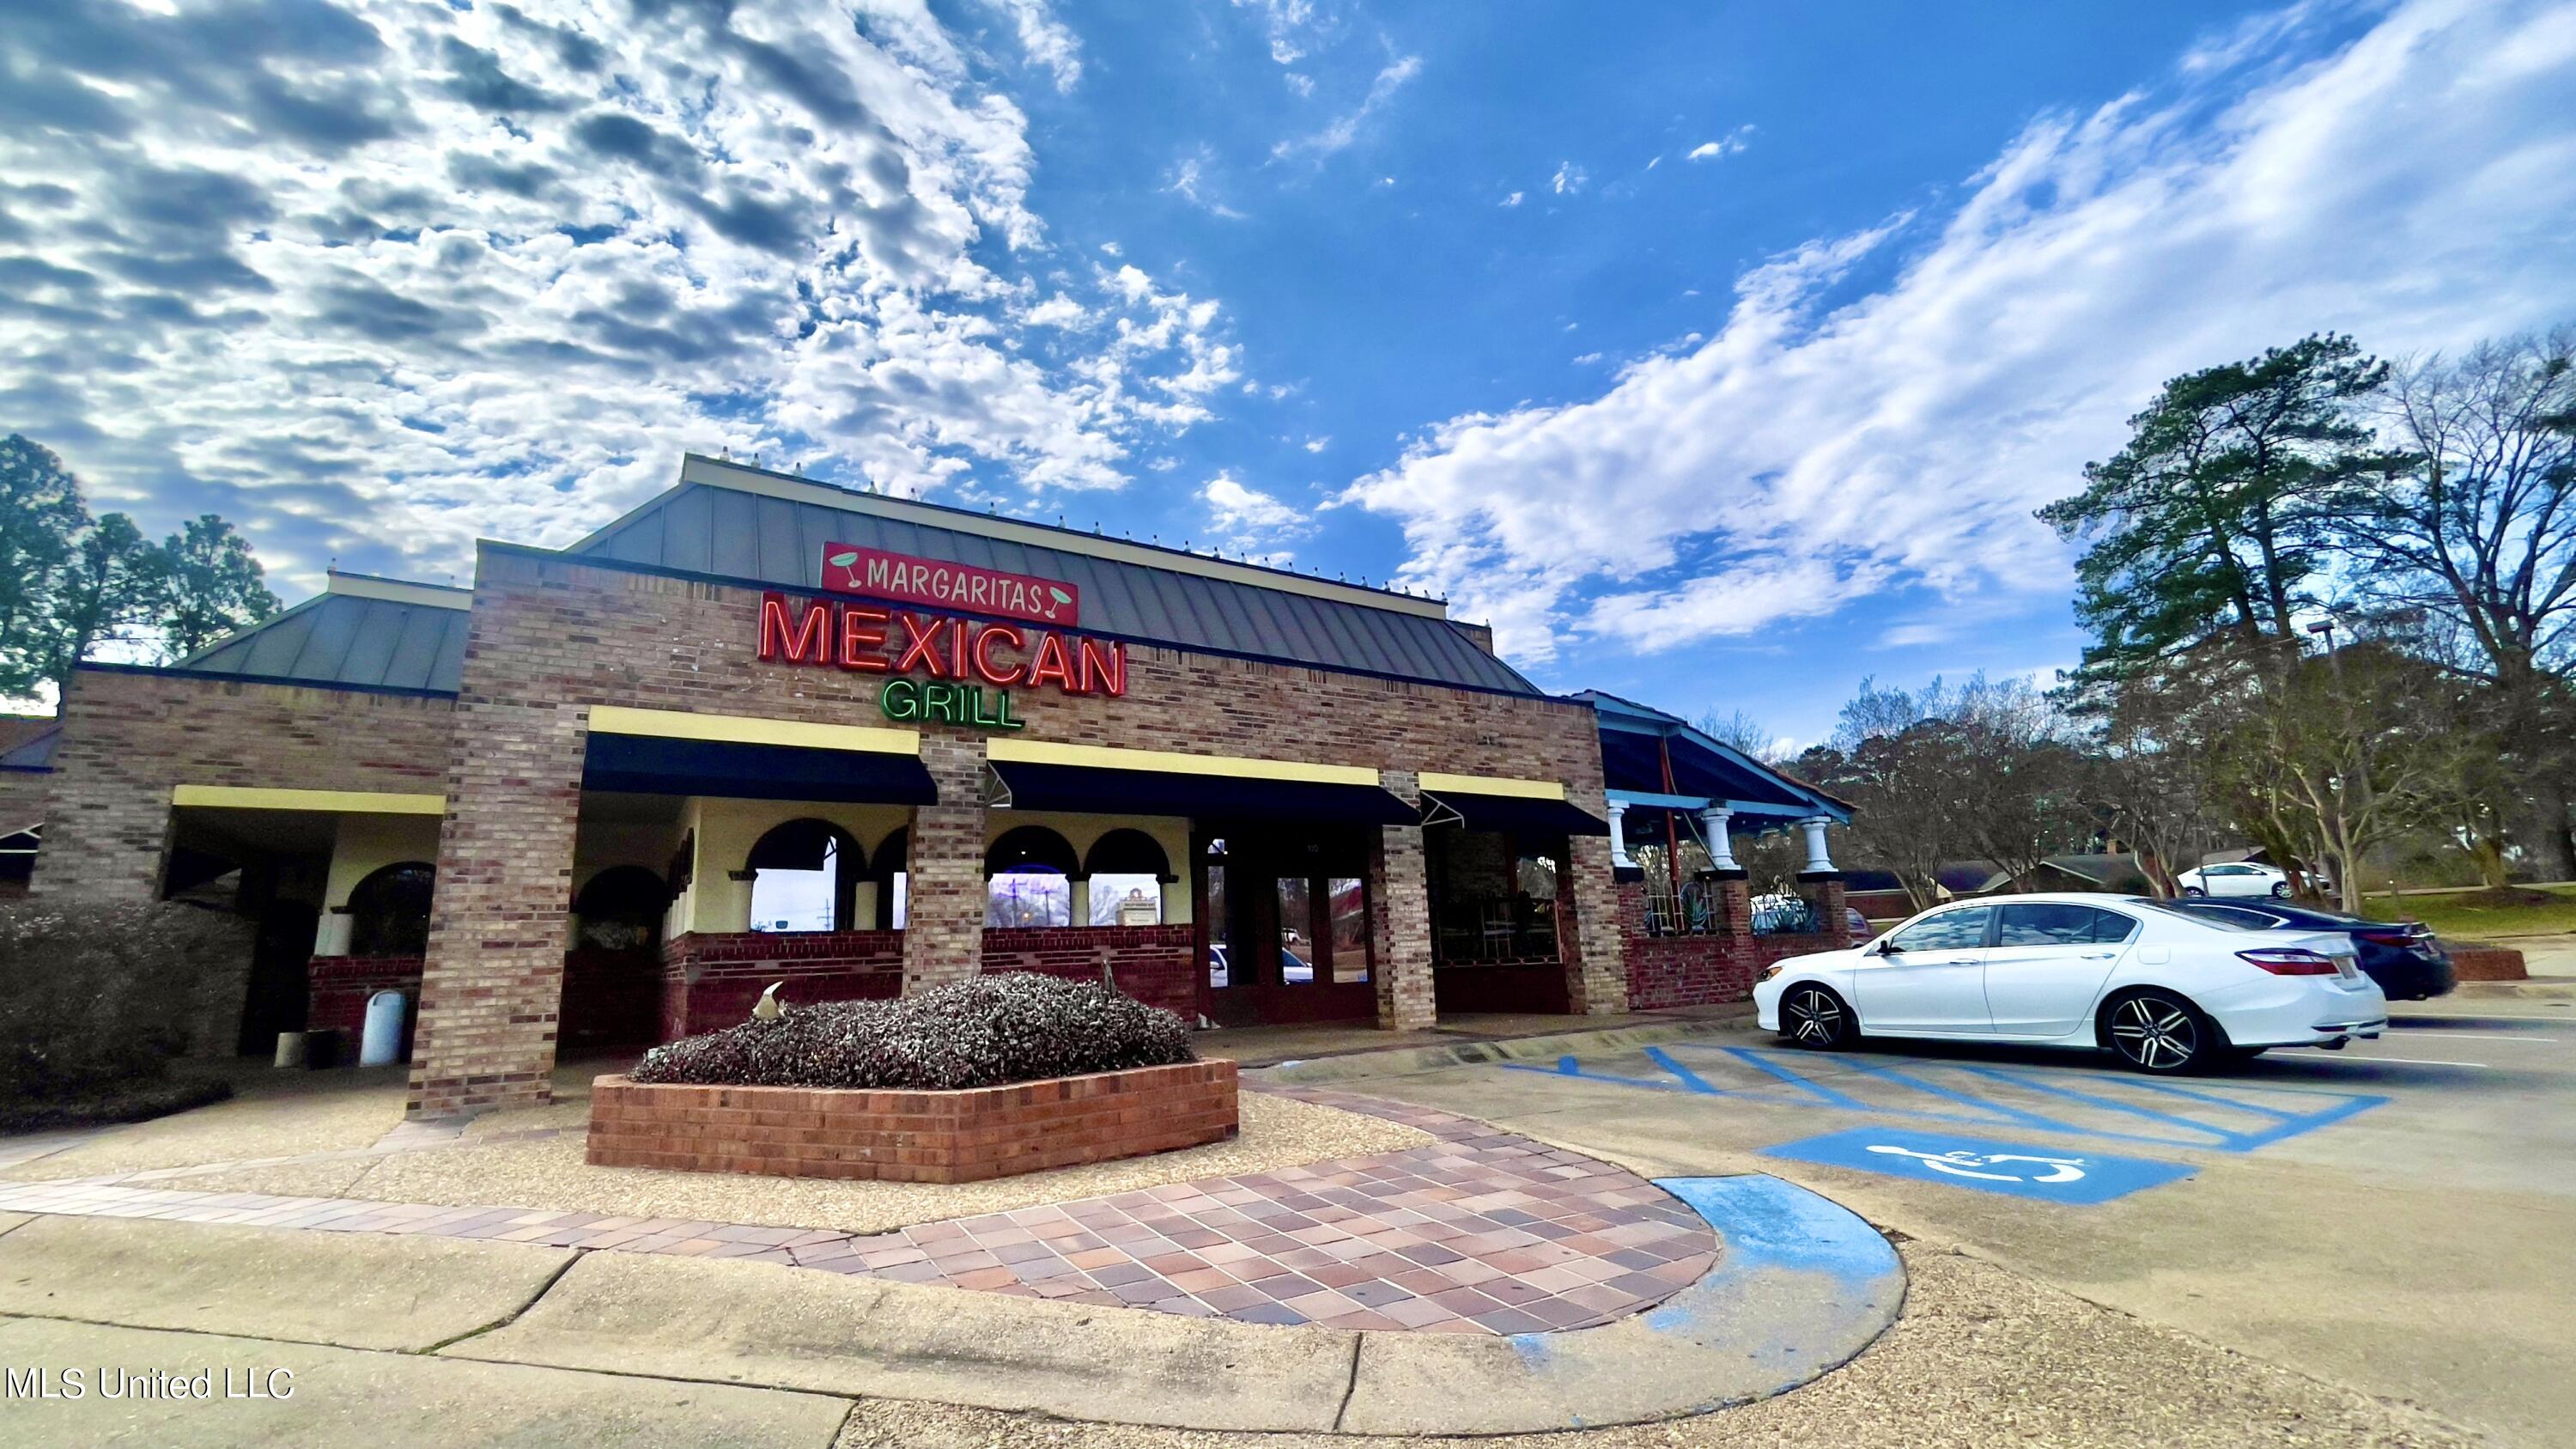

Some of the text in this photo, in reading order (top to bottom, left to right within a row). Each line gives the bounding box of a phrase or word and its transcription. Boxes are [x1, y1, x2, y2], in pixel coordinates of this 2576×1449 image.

[866, 558, 1042, 613] MARGARITAS
[757, 592, 1127, 697] MEXICAN
[880, 677, 1026, 730] GRILL
